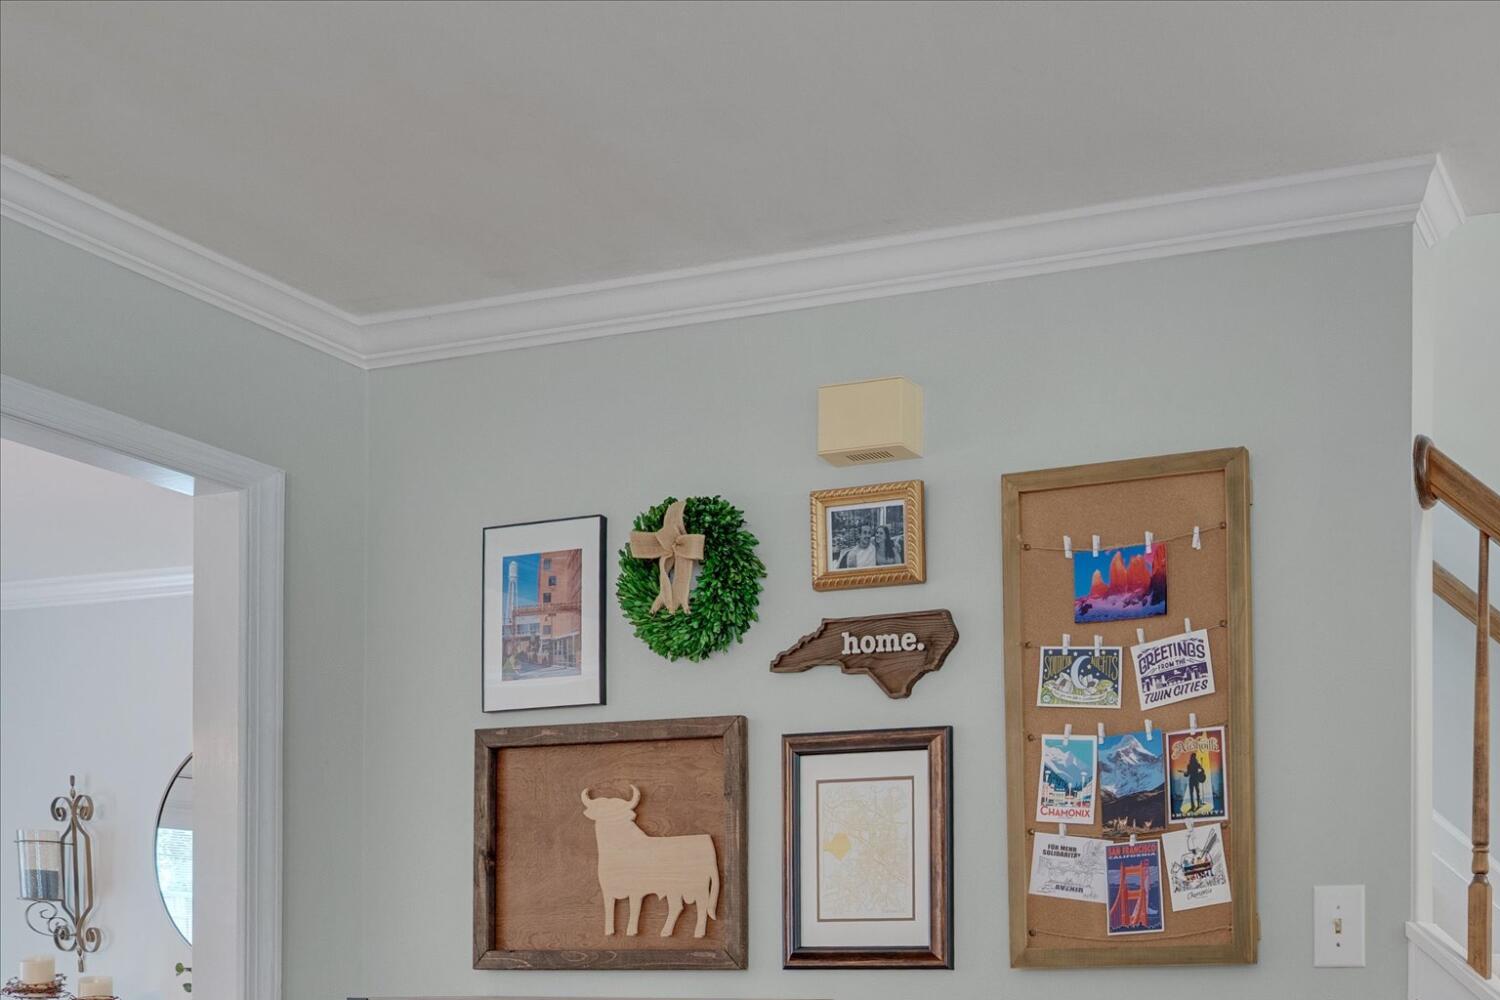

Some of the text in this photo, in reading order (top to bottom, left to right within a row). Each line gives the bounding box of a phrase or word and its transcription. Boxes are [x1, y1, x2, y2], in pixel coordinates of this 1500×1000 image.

[842, 632, 925, 655] home.
[1139, 641, 1206, 674] GREETINGS
[1158, 661, 1174, 669] FROM
[1145, 679, 1208, 704] TWIN CITIES
[1040, 804, 1090, 817] CHAMONIX
